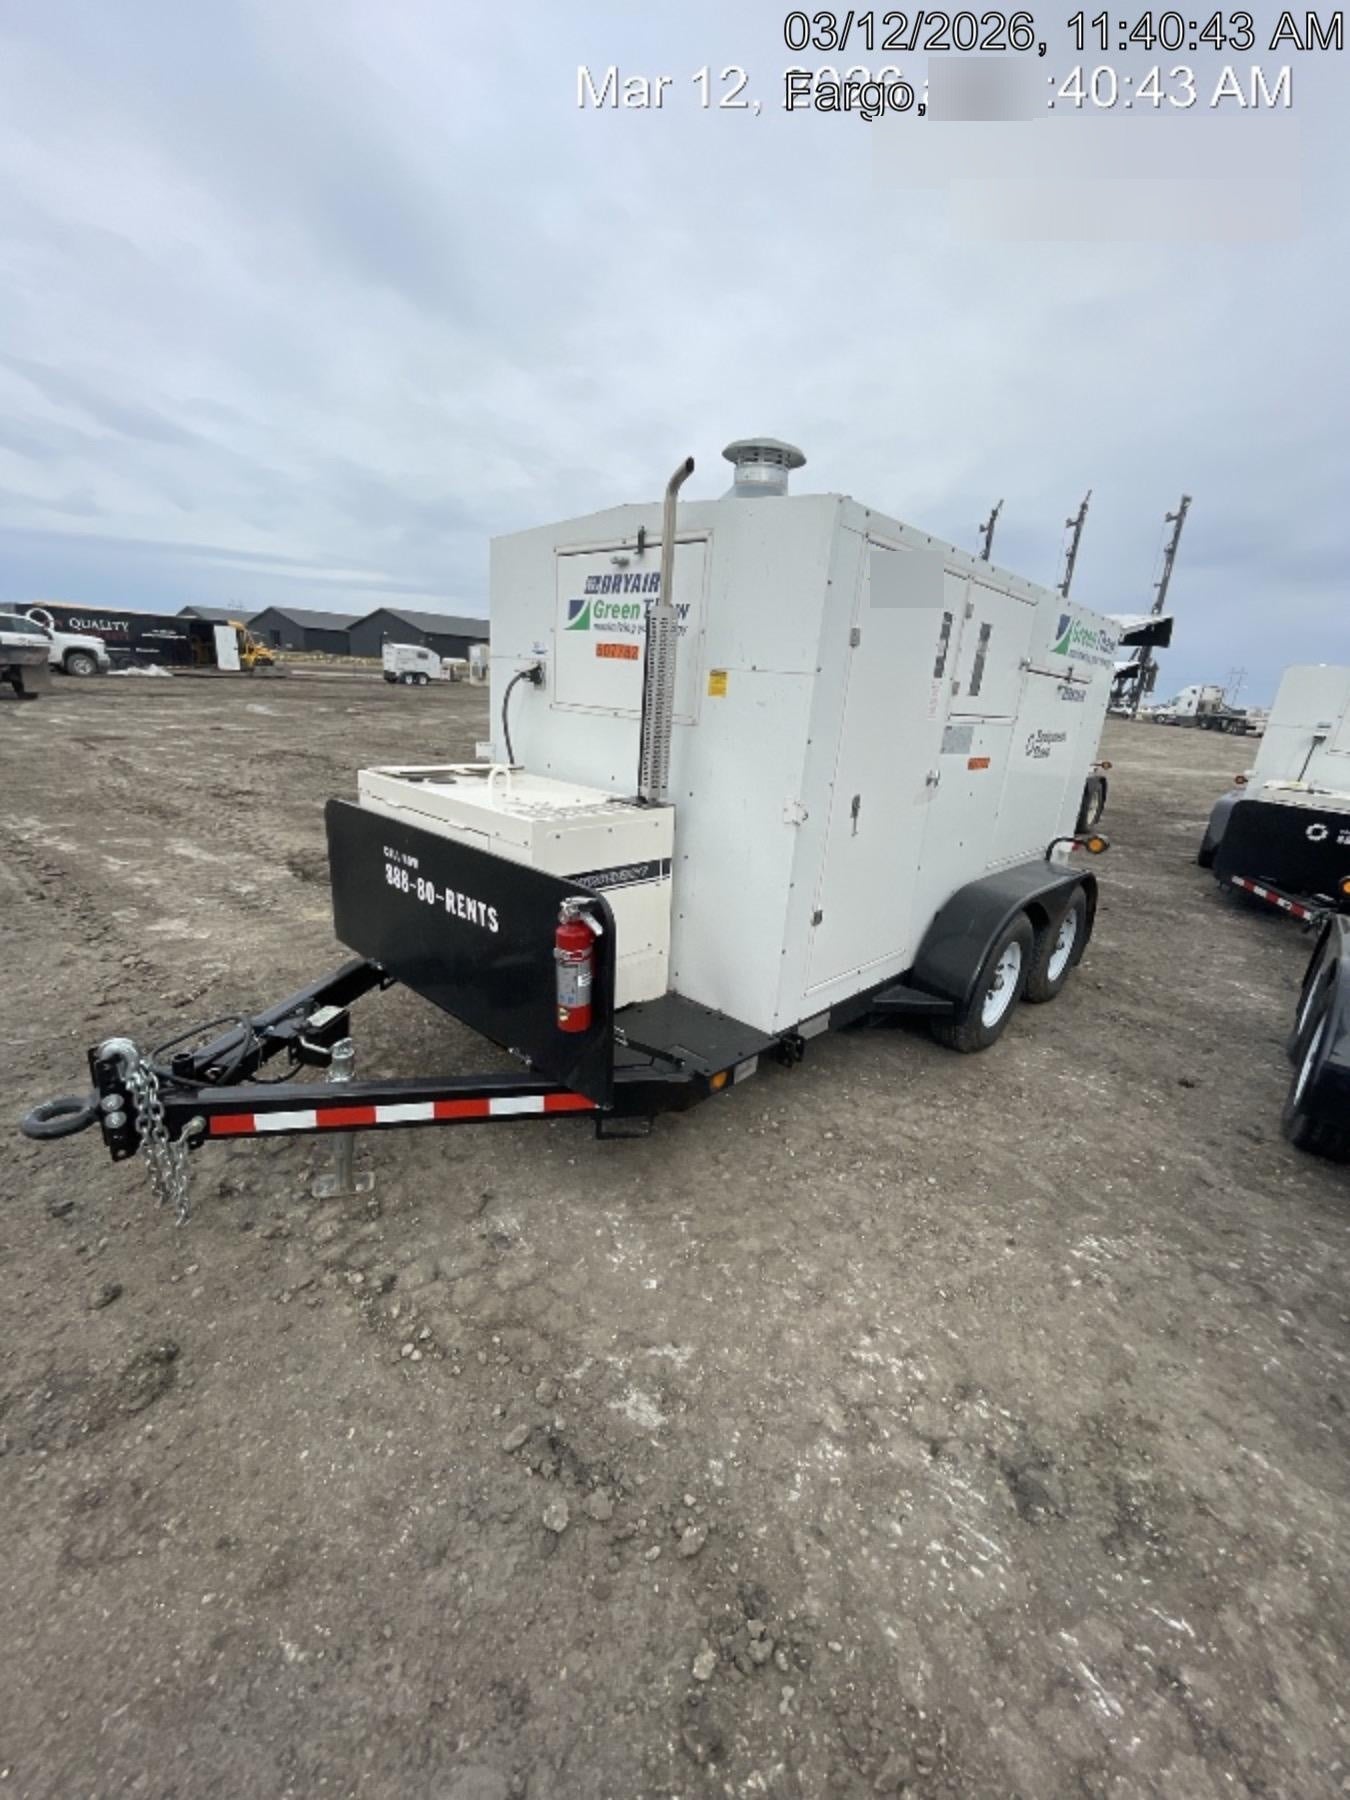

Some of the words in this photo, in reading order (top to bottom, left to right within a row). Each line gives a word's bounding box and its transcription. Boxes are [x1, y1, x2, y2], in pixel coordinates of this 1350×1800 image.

[593, 599, 640, 619] Green
[69, 616, 129, 632] QUALITY
[385, 863, 499, 933] 888-80-RENTS
